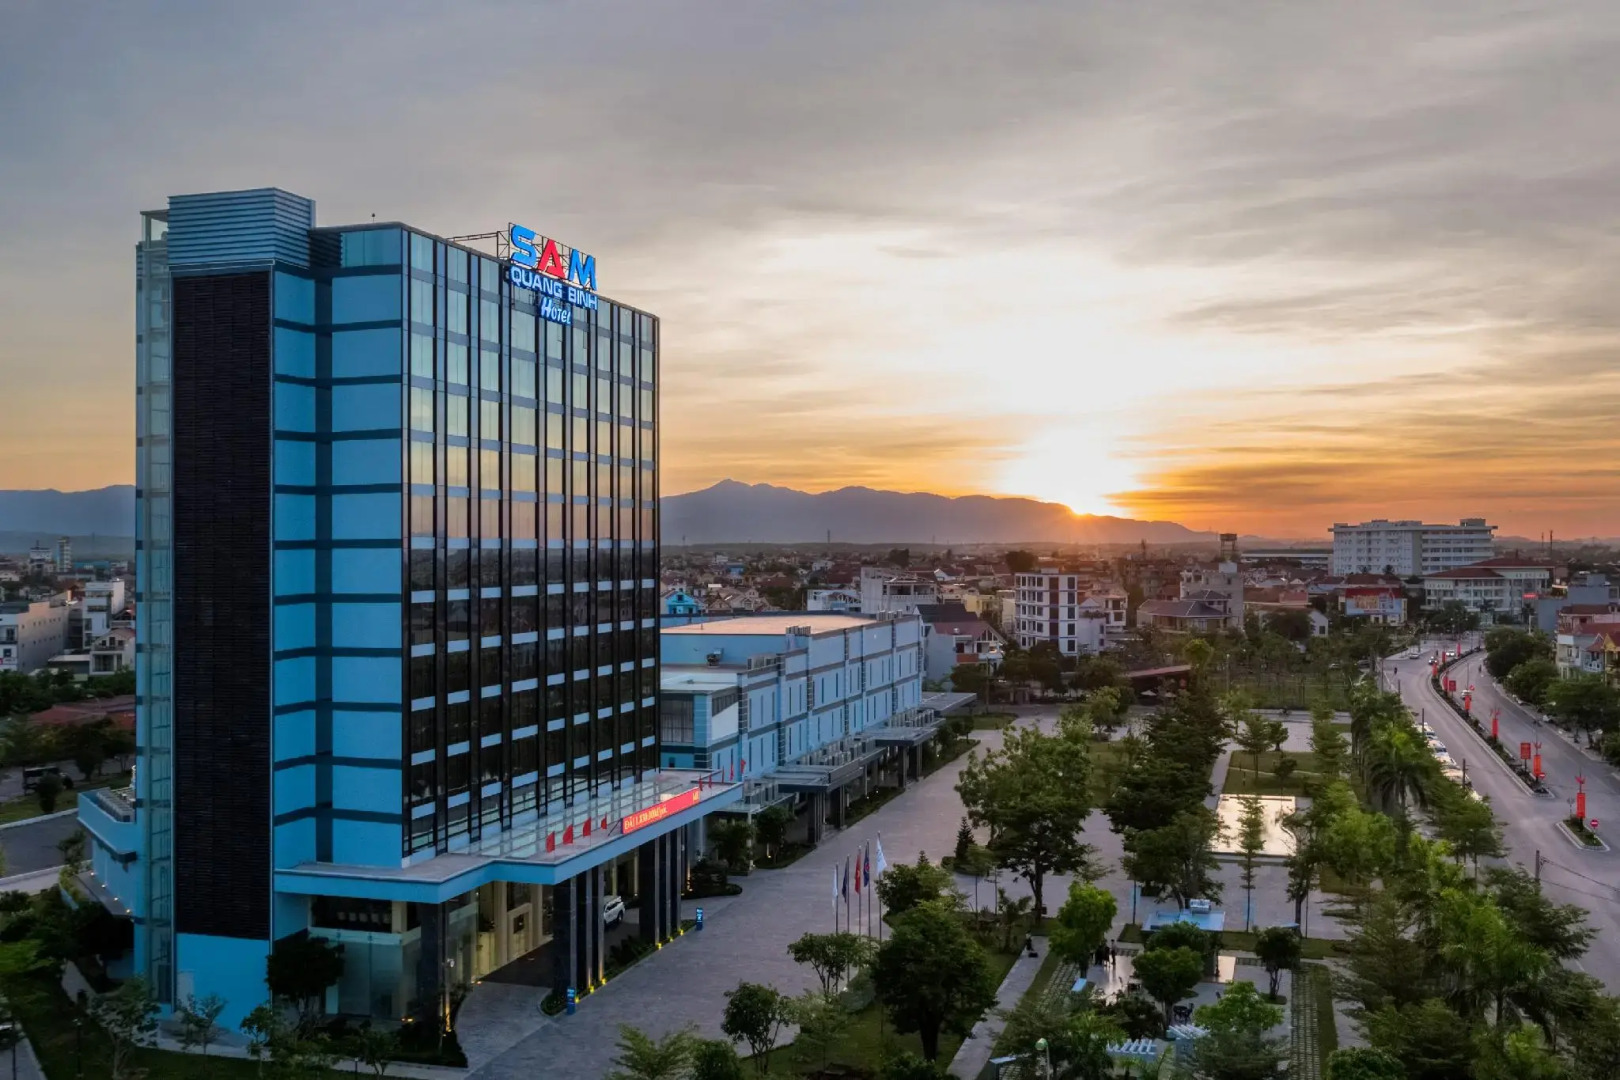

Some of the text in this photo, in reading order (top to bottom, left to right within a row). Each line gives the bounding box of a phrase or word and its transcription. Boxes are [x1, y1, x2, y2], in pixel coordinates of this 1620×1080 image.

[511, 224, 597, 291] SAM
[510, 266, 598, 310] QUANG BINH
